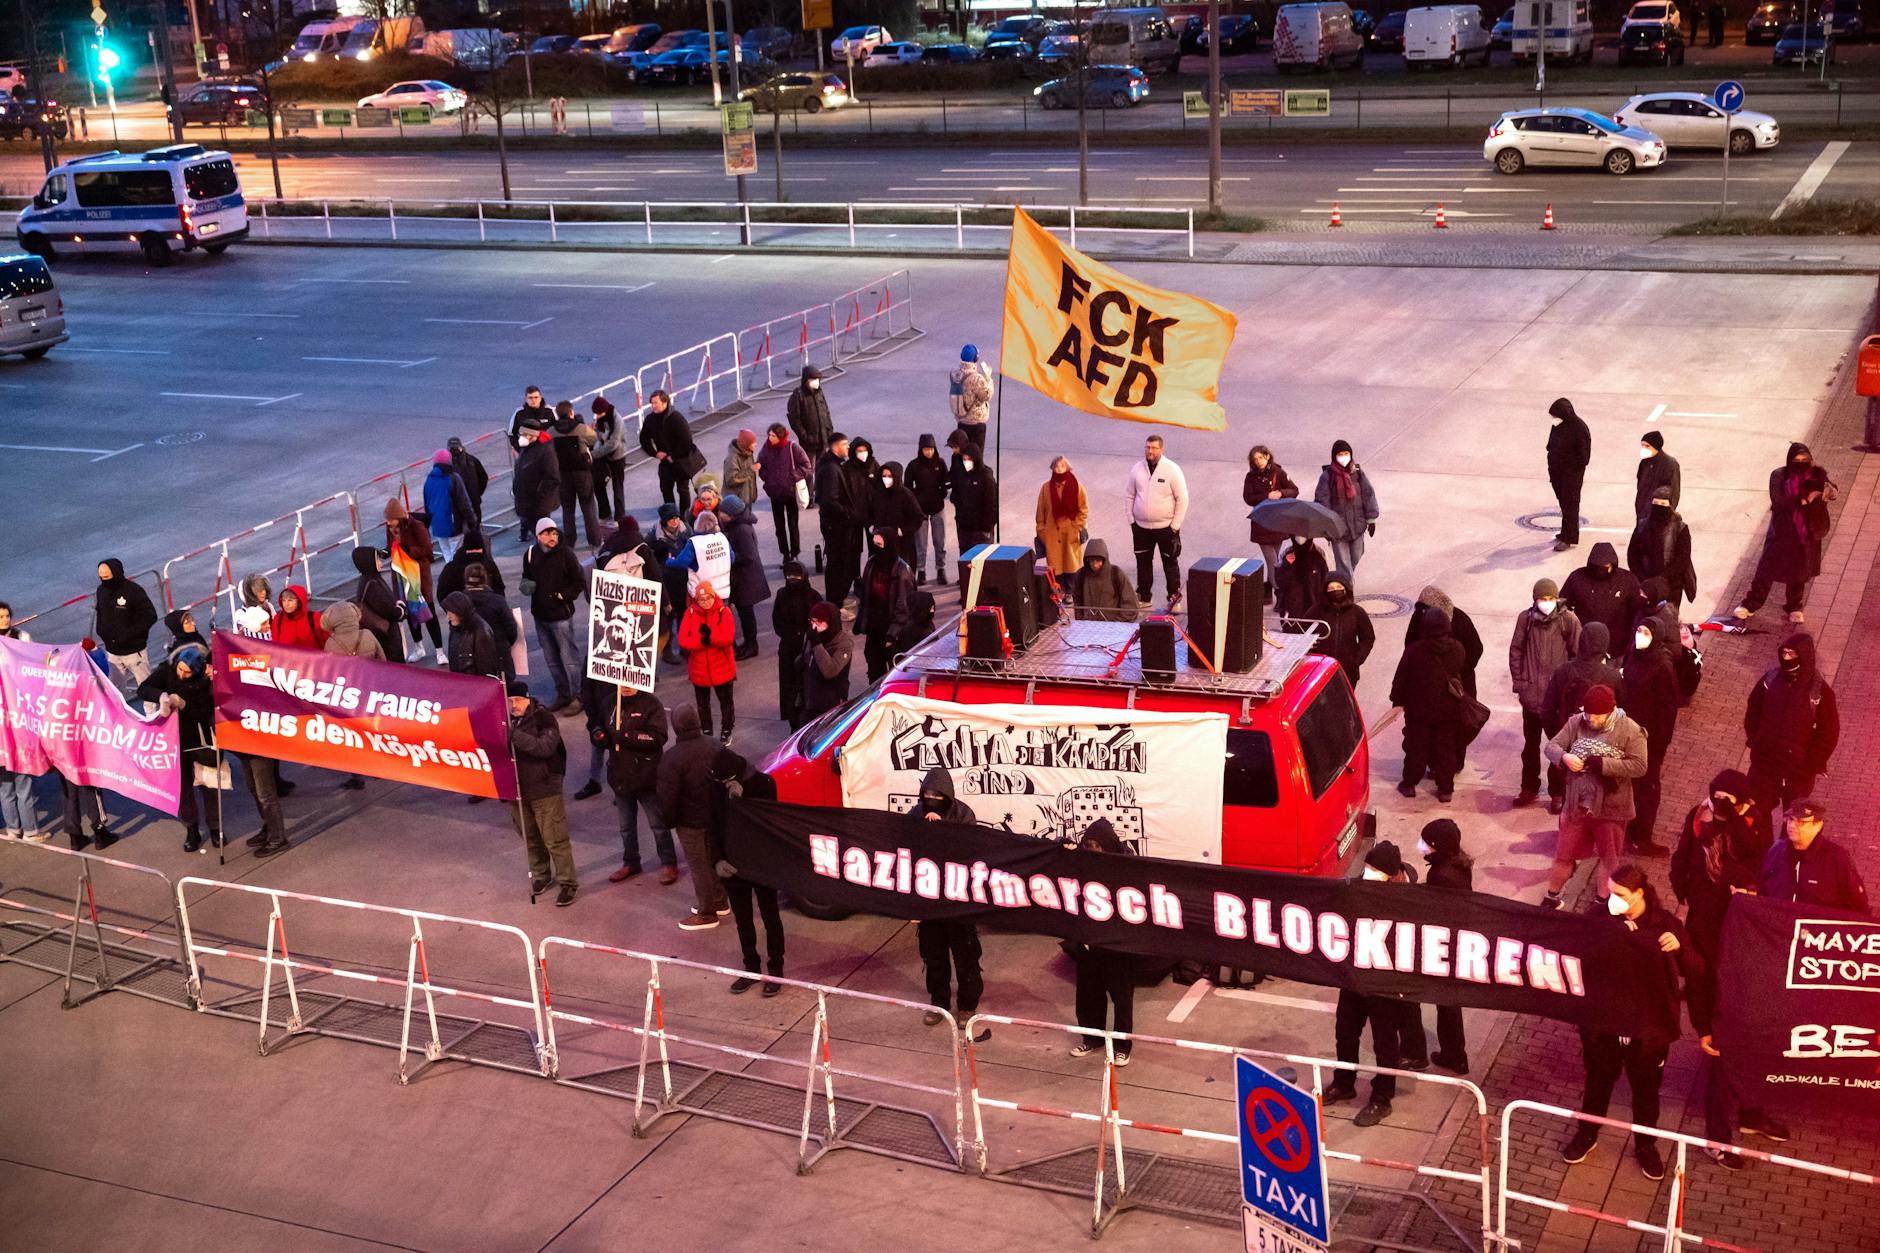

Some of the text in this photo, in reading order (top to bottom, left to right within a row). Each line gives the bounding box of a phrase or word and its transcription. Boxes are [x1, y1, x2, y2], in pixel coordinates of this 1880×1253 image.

[86, 210, 112, 219] POLIZEI
[1057, 260, 1180, 365] FCK
[1047, 323, 1157, 407] AFD
[705, 546, 724, 555] GEGEN
[706, 552, 727, 561] RECHTS
[595, 576, 656, 604] Nazis raus:
[21, 665, 80, 684] QUEERMANY
[591, 661, 651, 688] aus den Köpfen
[272, 667, 442, 725] Nazis raus:
[240, 707, 492, 773] aus den Köpfen!
[1015, 735, 1046, 767] DIE
[963, 765, 1031, 795] SIND
[809, 833, 1585, 997] Naziaufmarsch BLOCKIEREN!
[1766, 1074, 1841, 1086] RADIKALE
[1248, 1164, 1318, 1228] TAXI
[1259, 1227, 1266, 1249] 5
